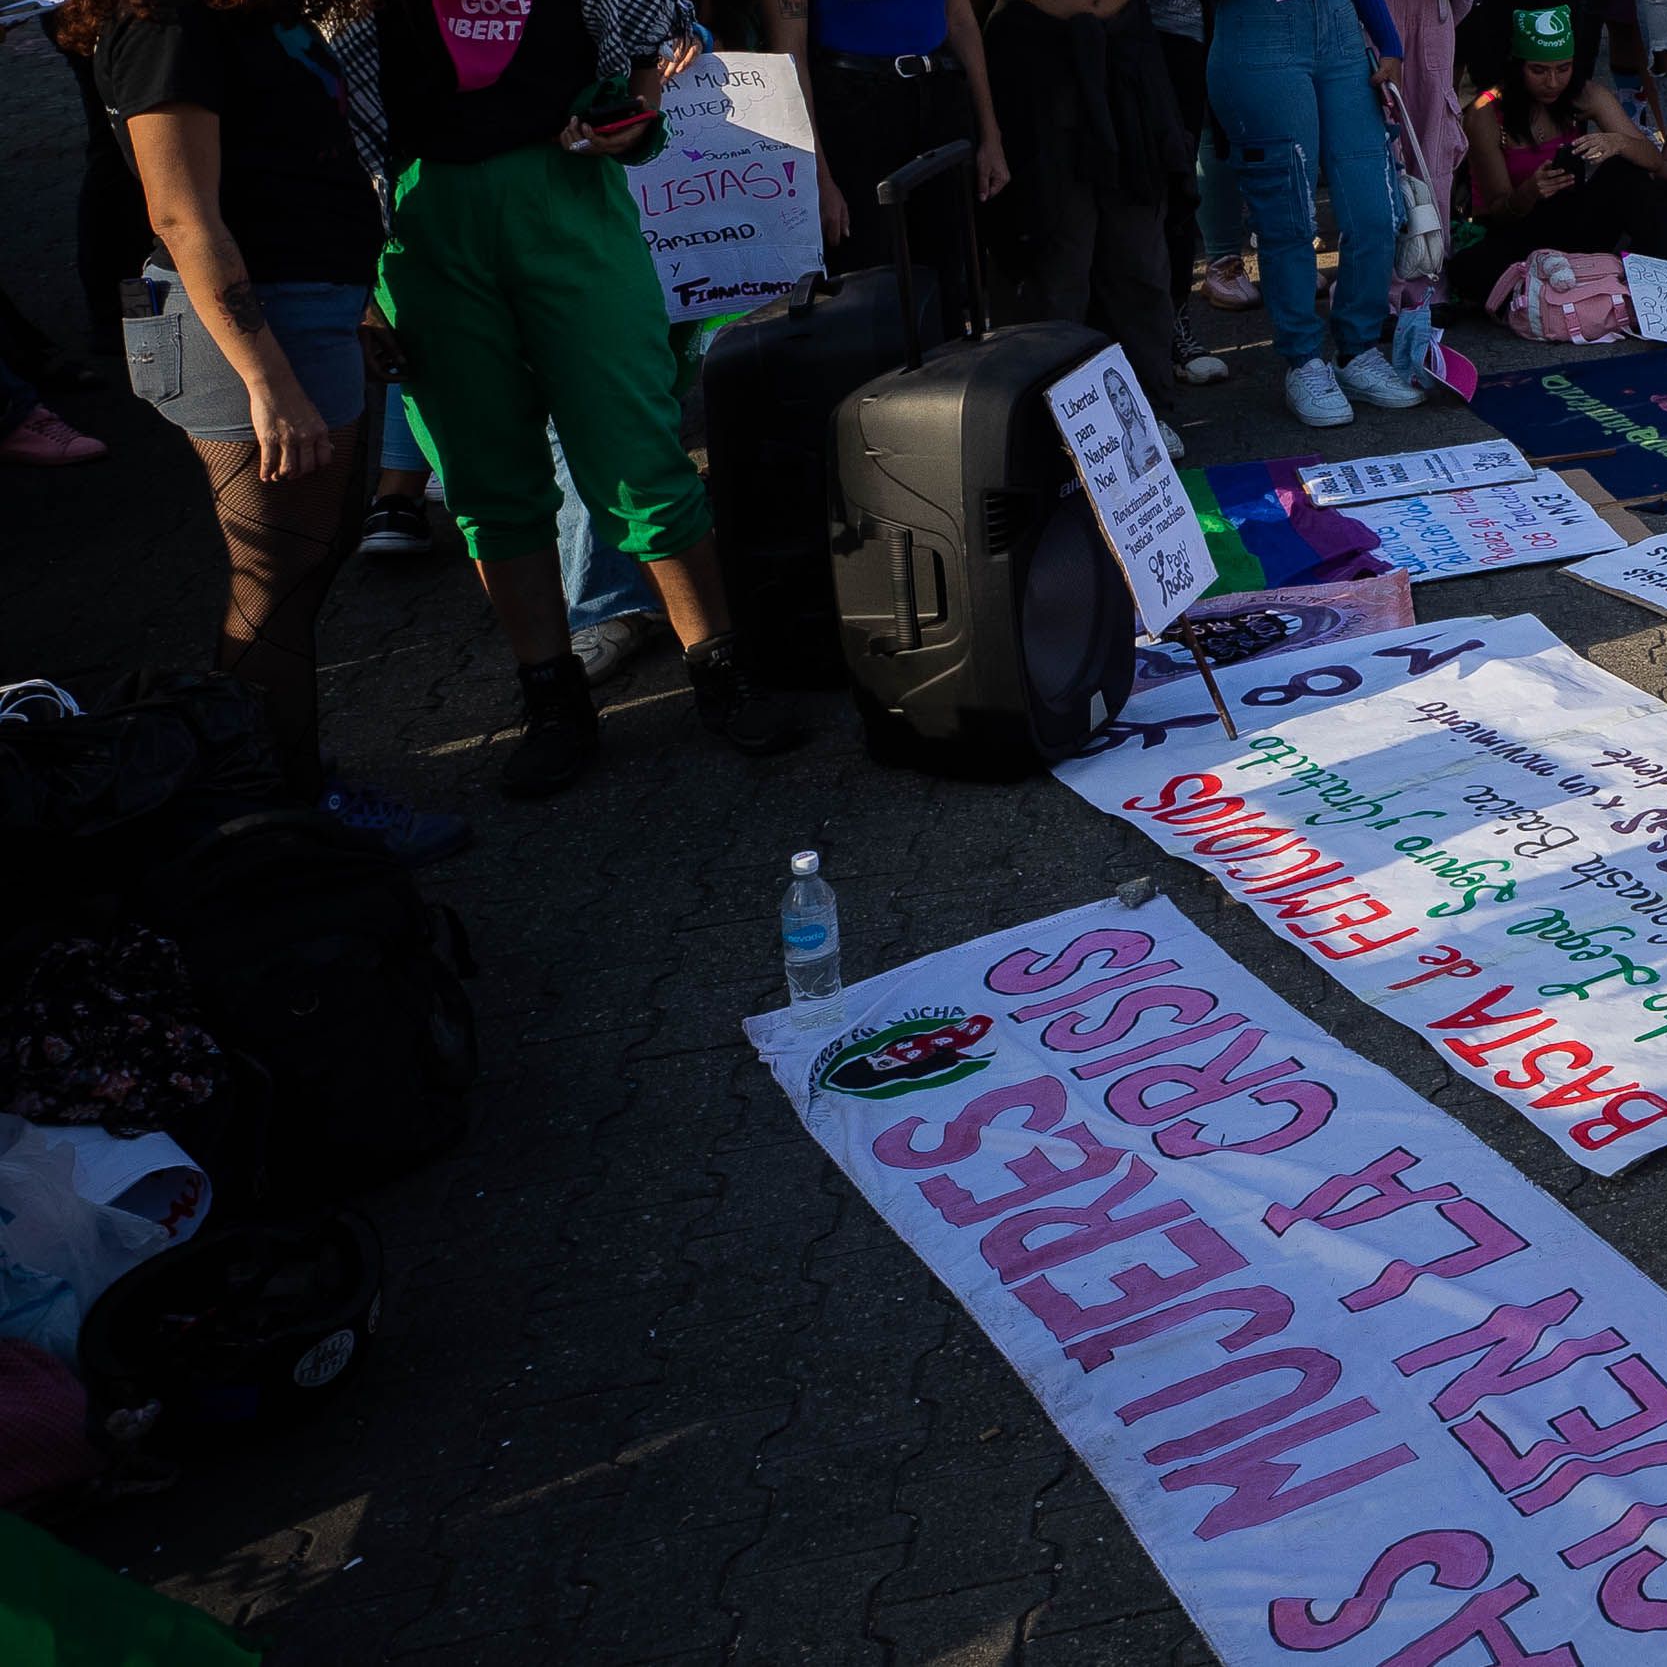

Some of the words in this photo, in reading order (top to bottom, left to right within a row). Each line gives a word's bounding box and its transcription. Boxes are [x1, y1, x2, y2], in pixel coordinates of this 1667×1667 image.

[696, 70, 765, 88] MUJER
[666, 99, 736, 121] MUJER
[641, 161, 797, 217] LISTAS!
[1060, 384, 1100, 420] Libertad
[1075, 422, 1097, 448] para
[1084, 436, 1121, 471] Naybelis
[1094, 466, 1118, 494] Noel
[1112, 485, 1160, 527] Revictimizada
[1159, 475, 1172, 494] por
[1127, 523, 1138, 537] un
[1138, 501, 1162, 528] sistema
[1162, 493, 1173, 508] de
[1155, 505, 1186, 536] machista
[1415, 700, 1559, 787] movimiento
[1246, 736, 1385, 825] Gratuito
[1122, 772, 1419, 962] FEMICIDIOS
[1392, 835, 1518, 918] Seguro
[1385, 945, 1480, 991] de
[1508, 908, 1660, 999] Legal
[983, 928, 1339, 1161] CRISIS
[1260, 1148, 1531, 1313] LA
[872, 1075, 1418, 1541] MUJERES
